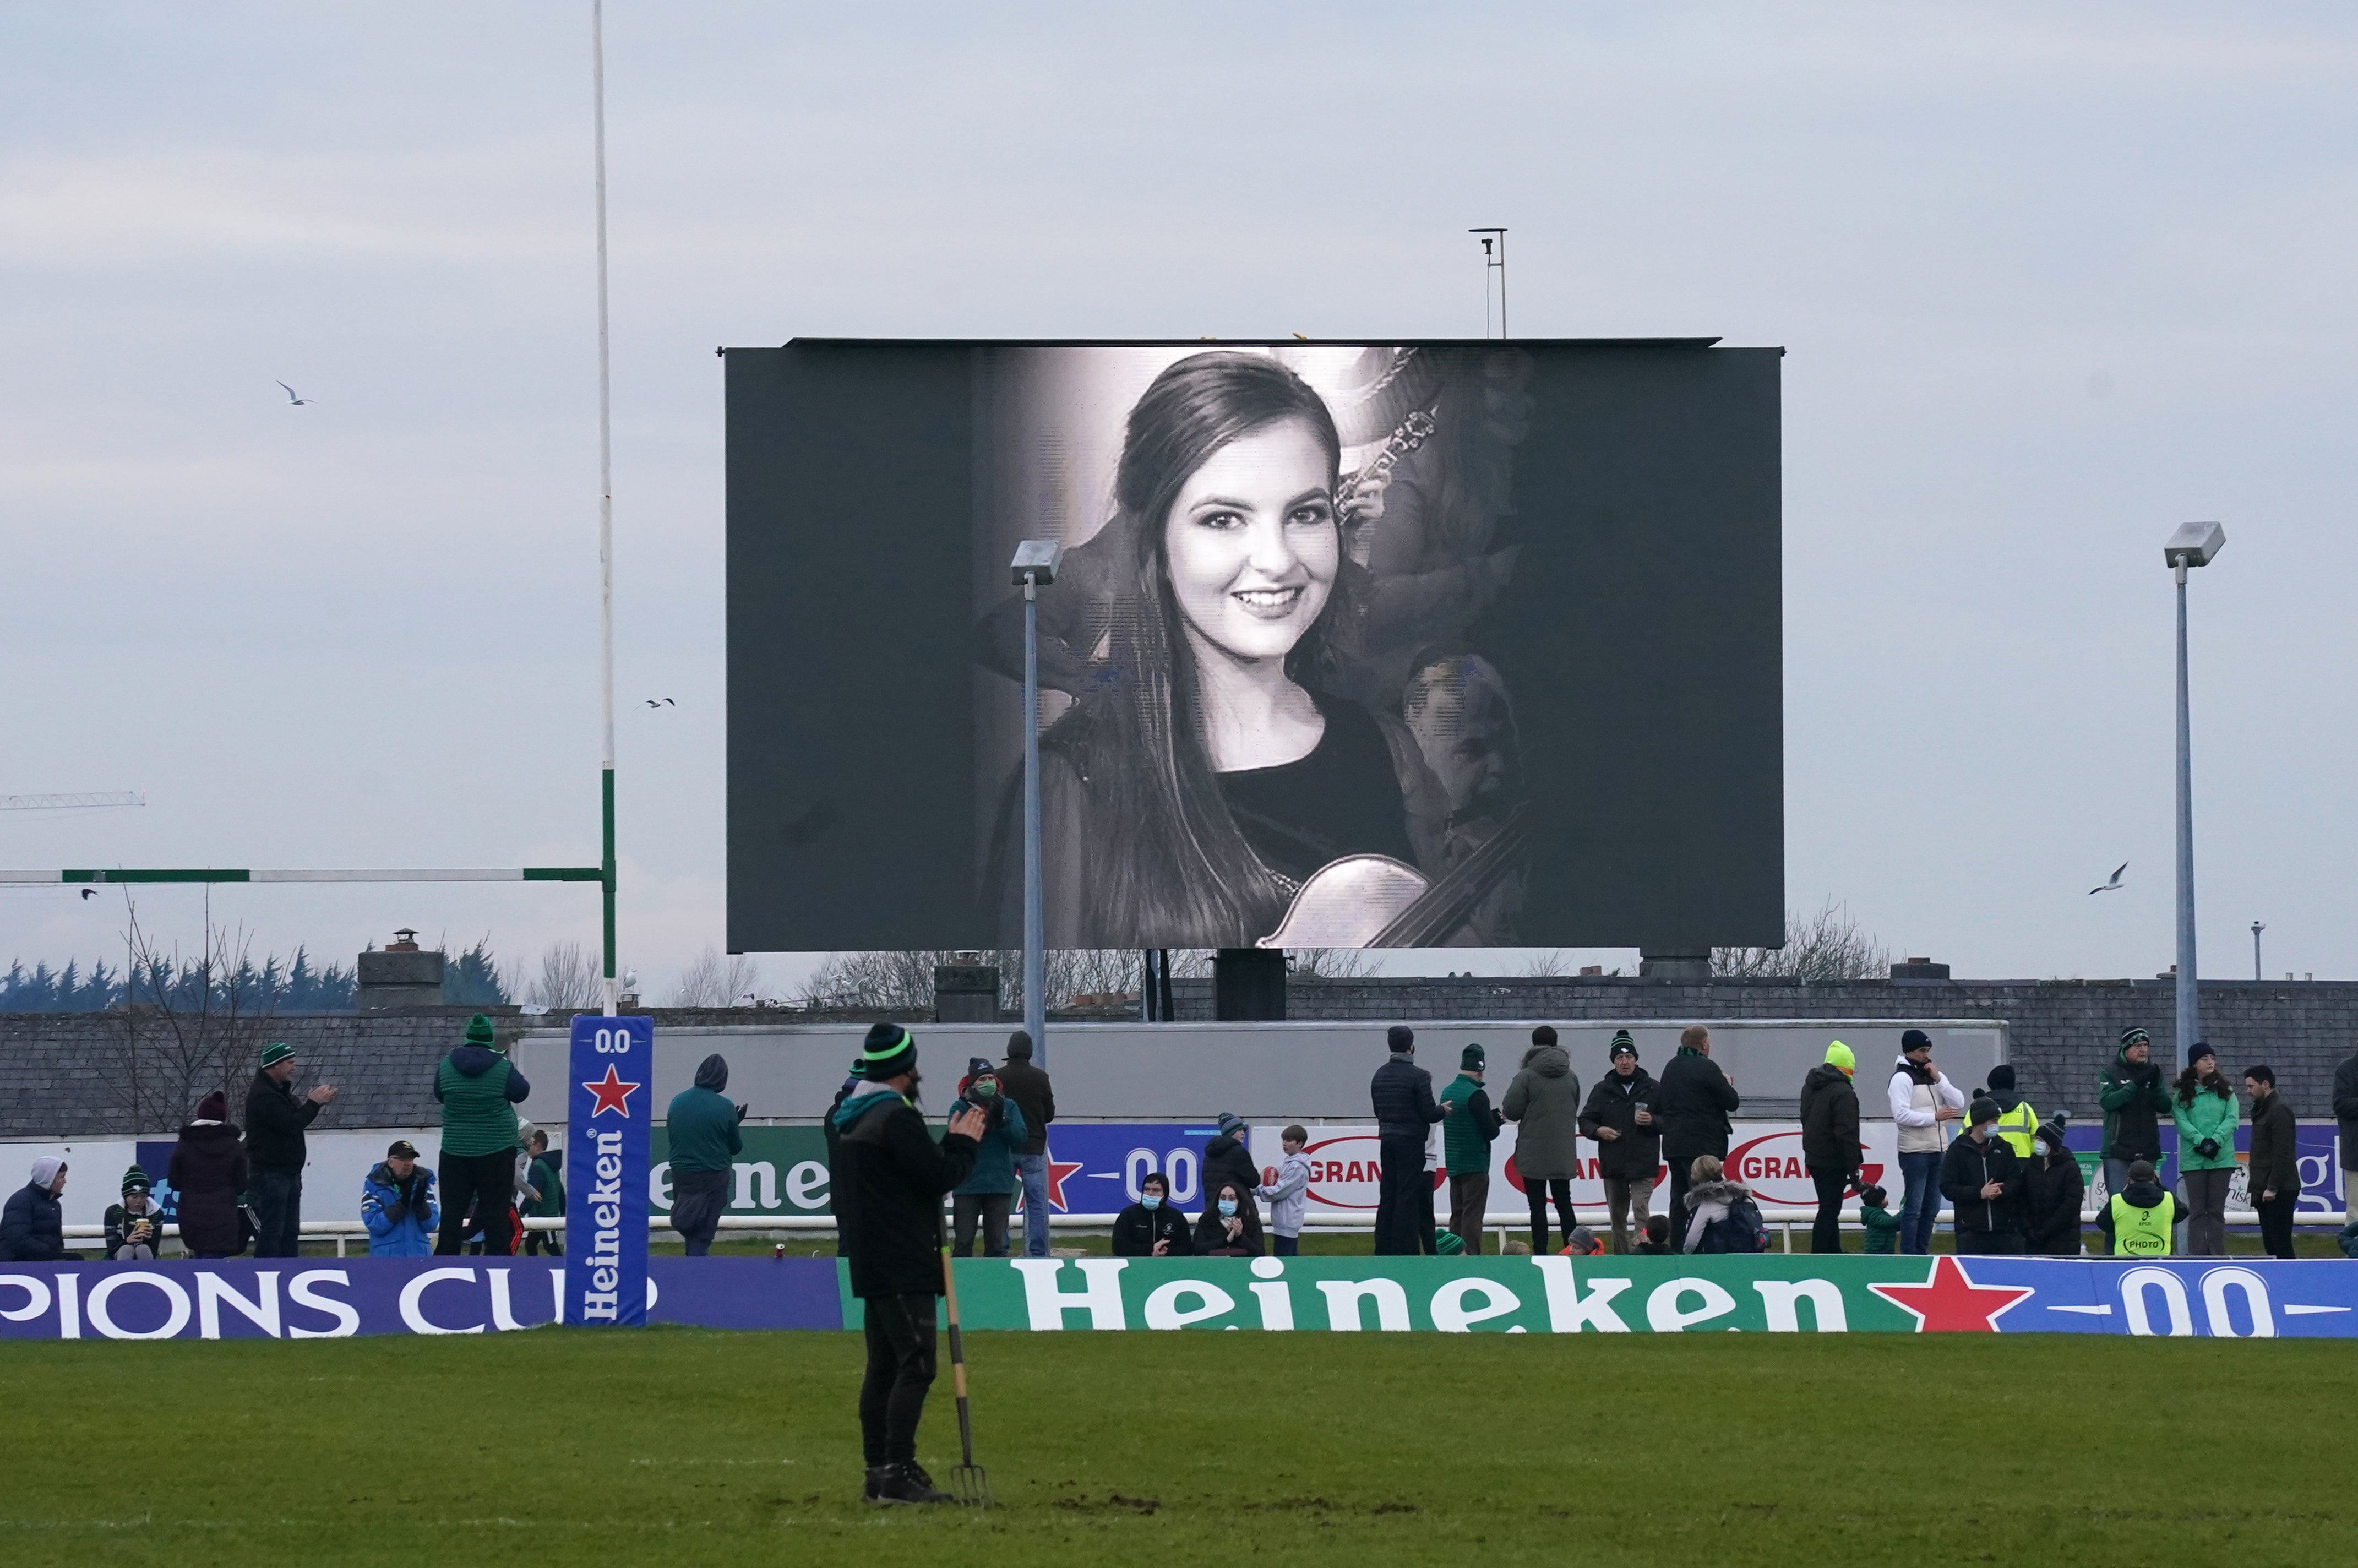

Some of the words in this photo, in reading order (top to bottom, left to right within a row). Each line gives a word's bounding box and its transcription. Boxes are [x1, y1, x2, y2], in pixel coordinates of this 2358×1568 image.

[595, 1028, 630, 1053] 0.0
[1309, 1161, 1382, 1183] GRAN
[584, 1130, 623, 1321] Heineken
[399, 1267, 658, 1335] CU
[1010, 1256, 1848, 1332] Heineken
